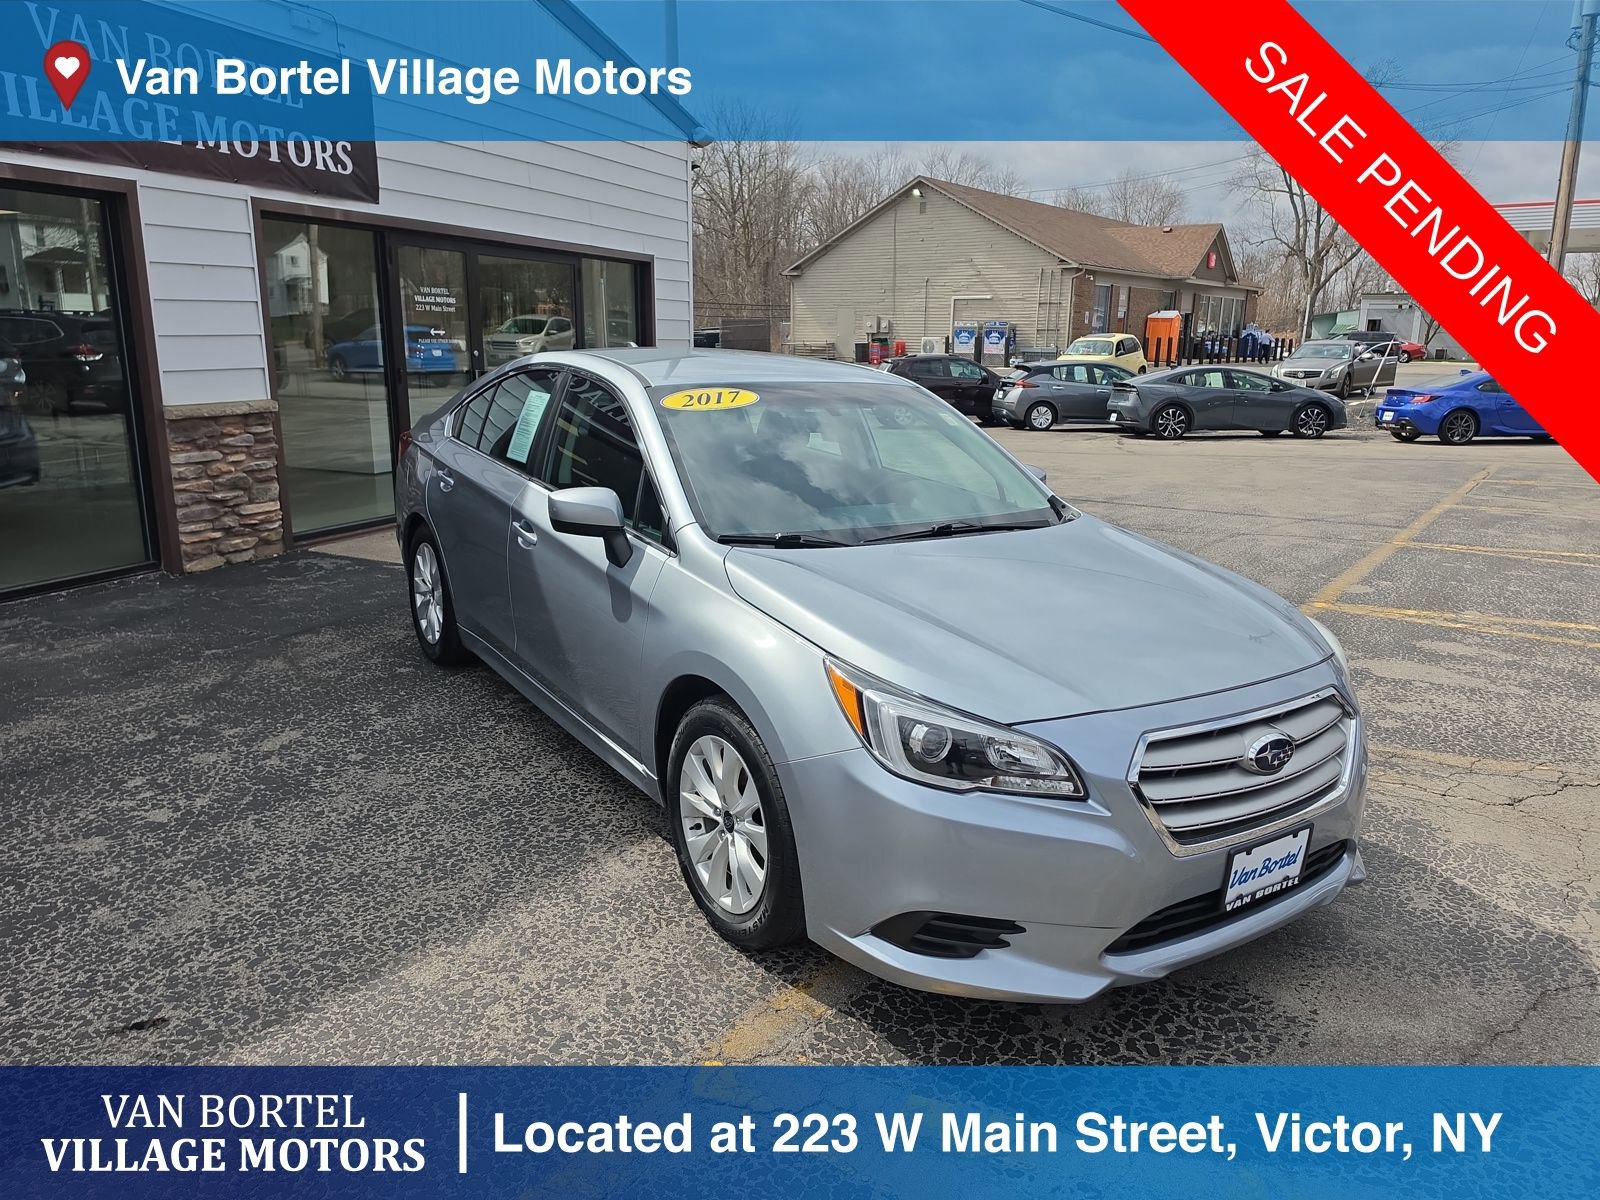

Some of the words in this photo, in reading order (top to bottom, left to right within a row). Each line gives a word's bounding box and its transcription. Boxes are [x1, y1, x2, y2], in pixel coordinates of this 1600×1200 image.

[0, 71, 183, 146] ILLAGE
[192, 111, 354, 175] MOTORS
[414, 294, 435, 302] VILLAGE
[436, 296, 456, 304] MOTORS
[681, 391, 740, 407] 2017
[1226, 894, 1252, 912] VAN
[1255, 876, 1300, 899] BORTEL
